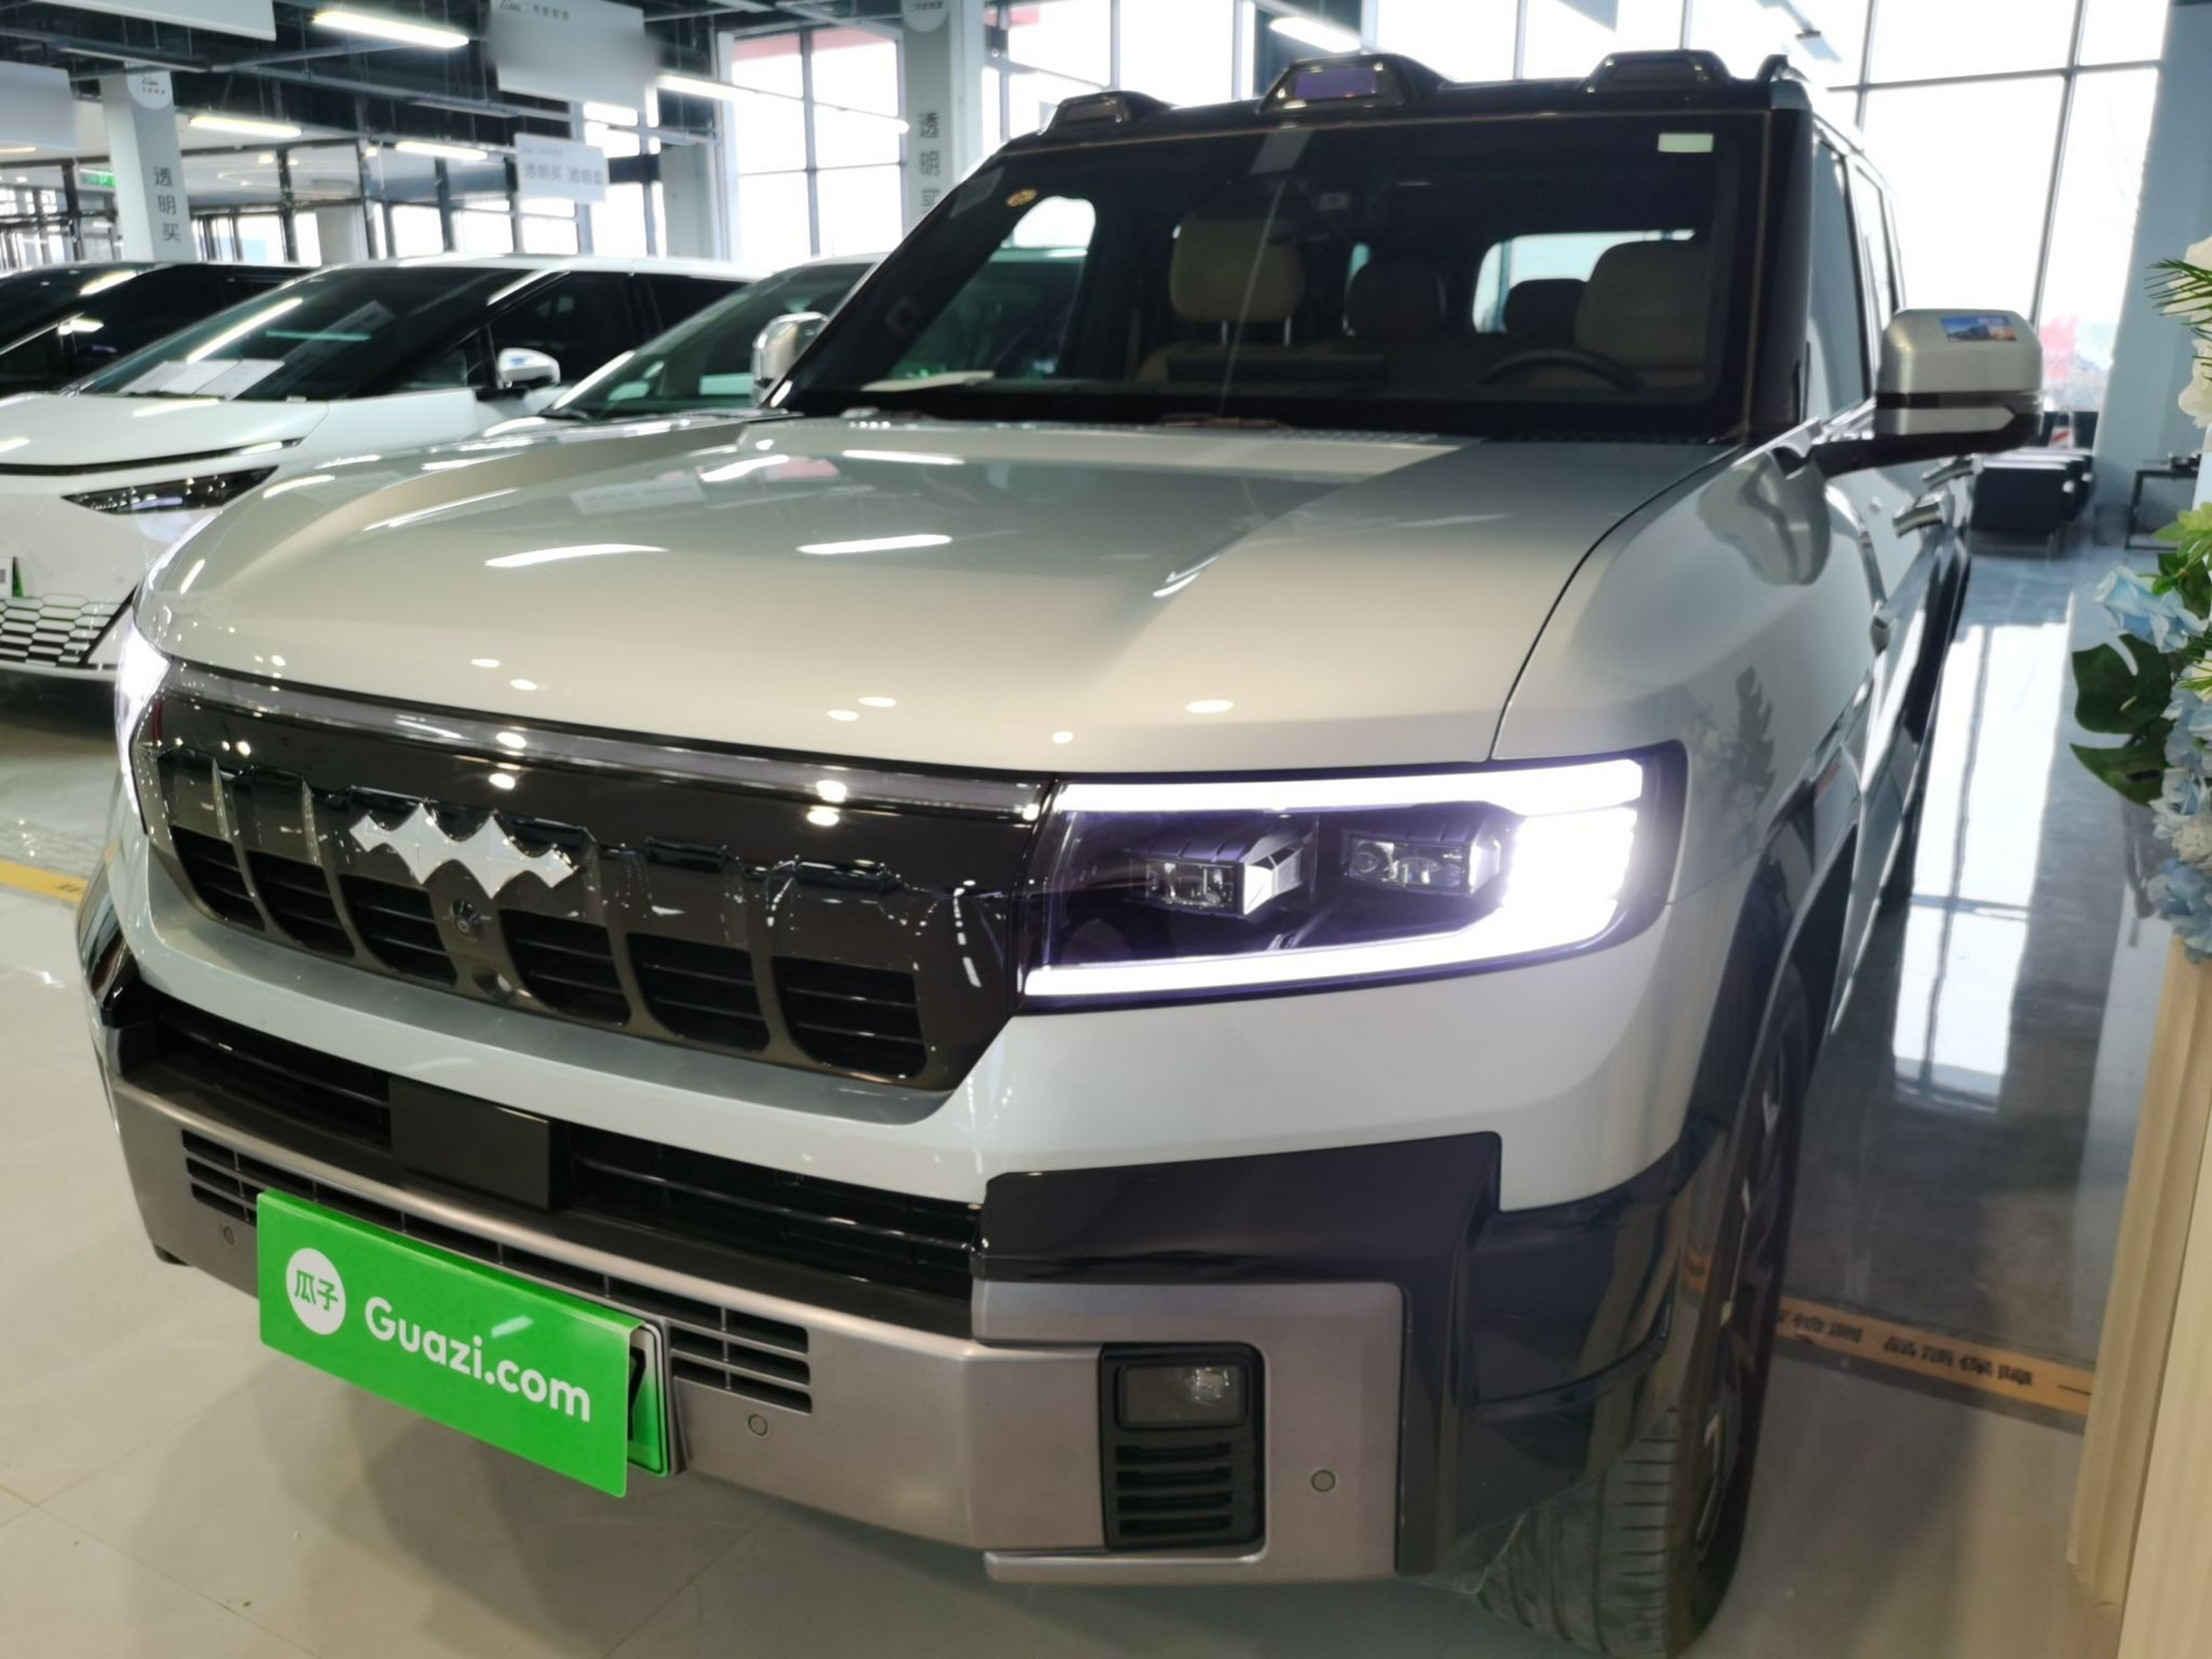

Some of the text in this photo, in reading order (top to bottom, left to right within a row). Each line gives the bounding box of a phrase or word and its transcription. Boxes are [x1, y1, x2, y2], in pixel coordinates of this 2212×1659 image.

[153, 165, 181, 243] 透明买
[294, 1269, 339, 1312] 瓜子
[365, 1296, 590, 1423] Guazi.com
